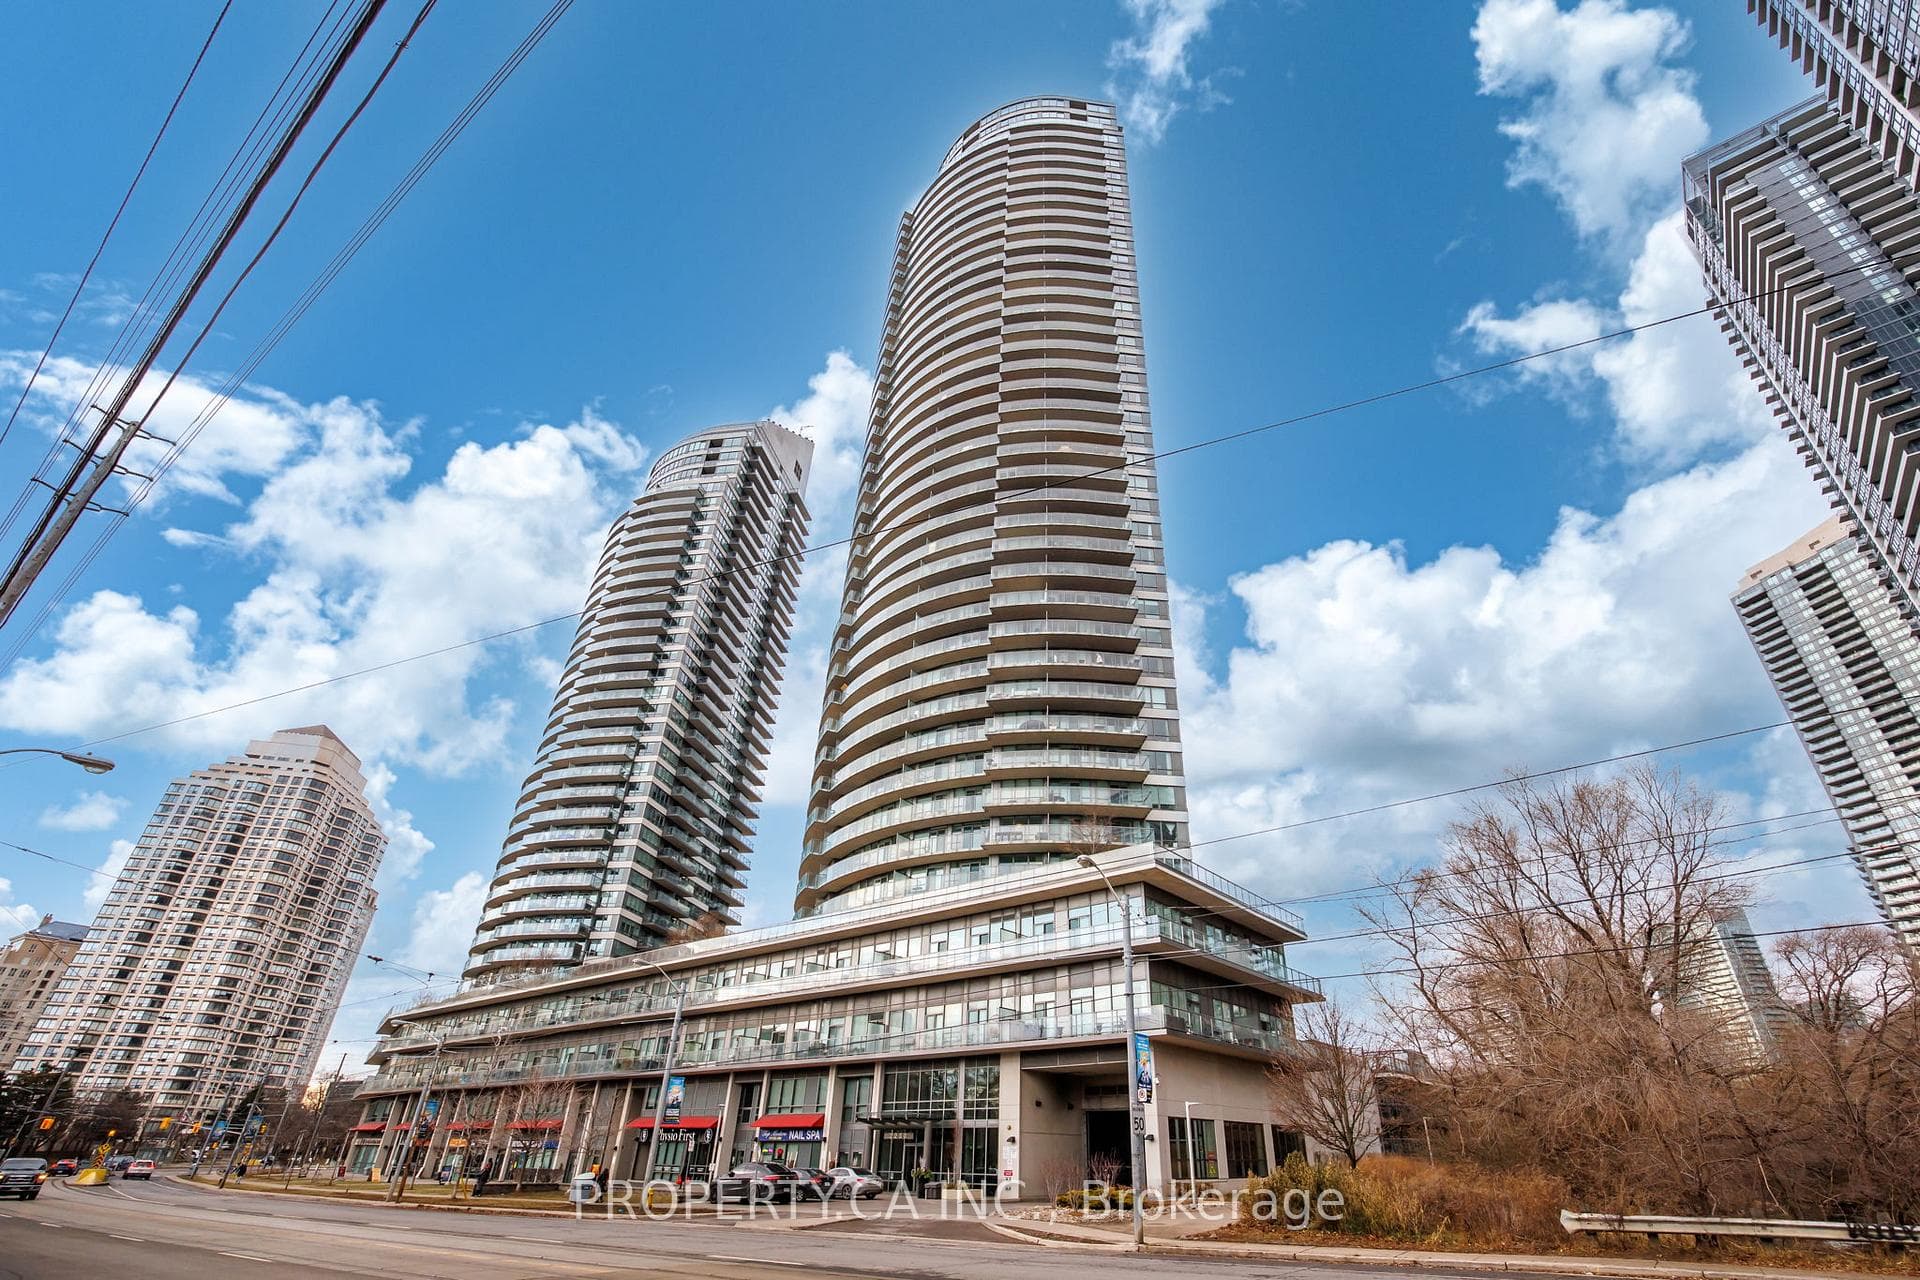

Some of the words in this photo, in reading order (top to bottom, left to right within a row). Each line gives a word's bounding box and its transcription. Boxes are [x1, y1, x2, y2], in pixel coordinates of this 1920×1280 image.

[1134, 1117, 1144, 1130] 50
[678, 1128, 696, 1142] First
[788, 1130, 805, 1140] NAIL
[806, 1130, 820, 1140] SPA
